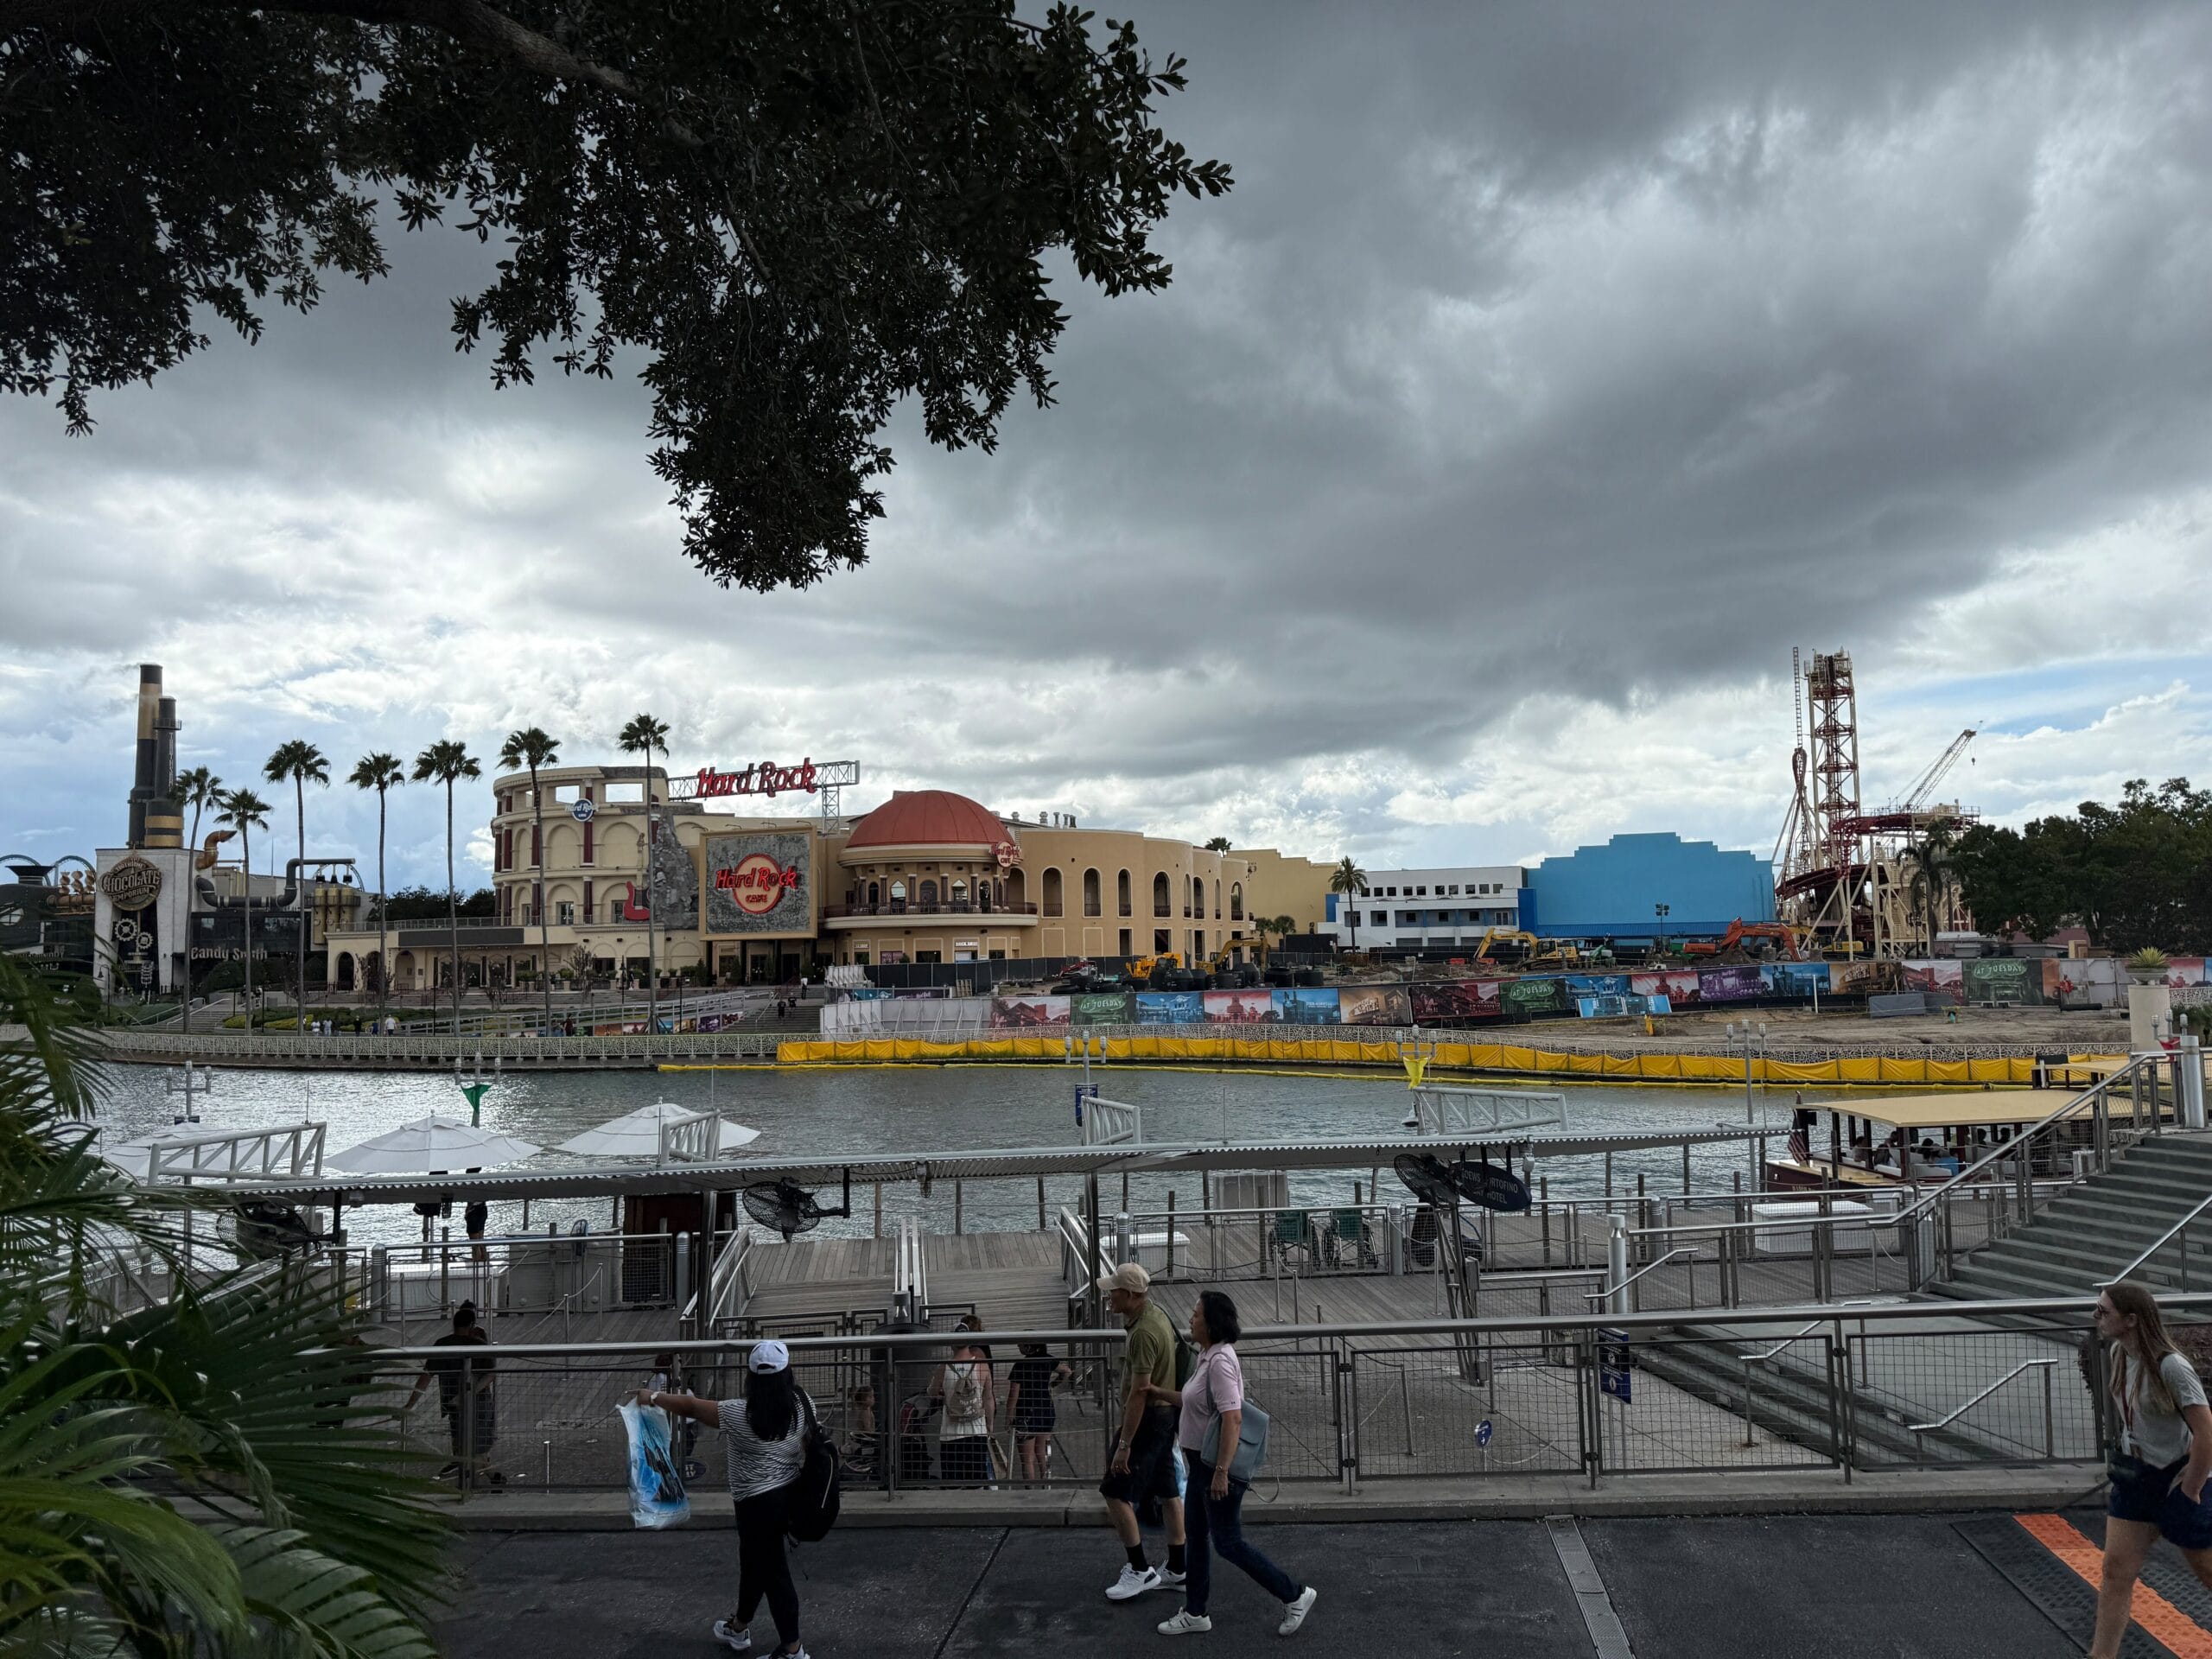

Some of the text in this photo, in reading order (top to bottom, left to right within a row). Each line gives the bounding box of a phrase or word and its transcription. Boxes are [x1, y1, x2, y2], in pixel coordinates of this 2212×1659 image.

[696, 757, 817, 798] Hard Rock
[564, 803, 599, 812] Hard Rock
[100, 869, 161, 893] CHOCOLATE
[715, 865, 798, 891] Hard Rock
[746, 894, 768, 903] CAFE
[191, 947, 229, 962] Candy
[1988, 964, 2022, 973] TUESDAY
[1523, 985, 1552, 995] TUESDAY
[1094, 998, 1122, 1008] TUESDAY
